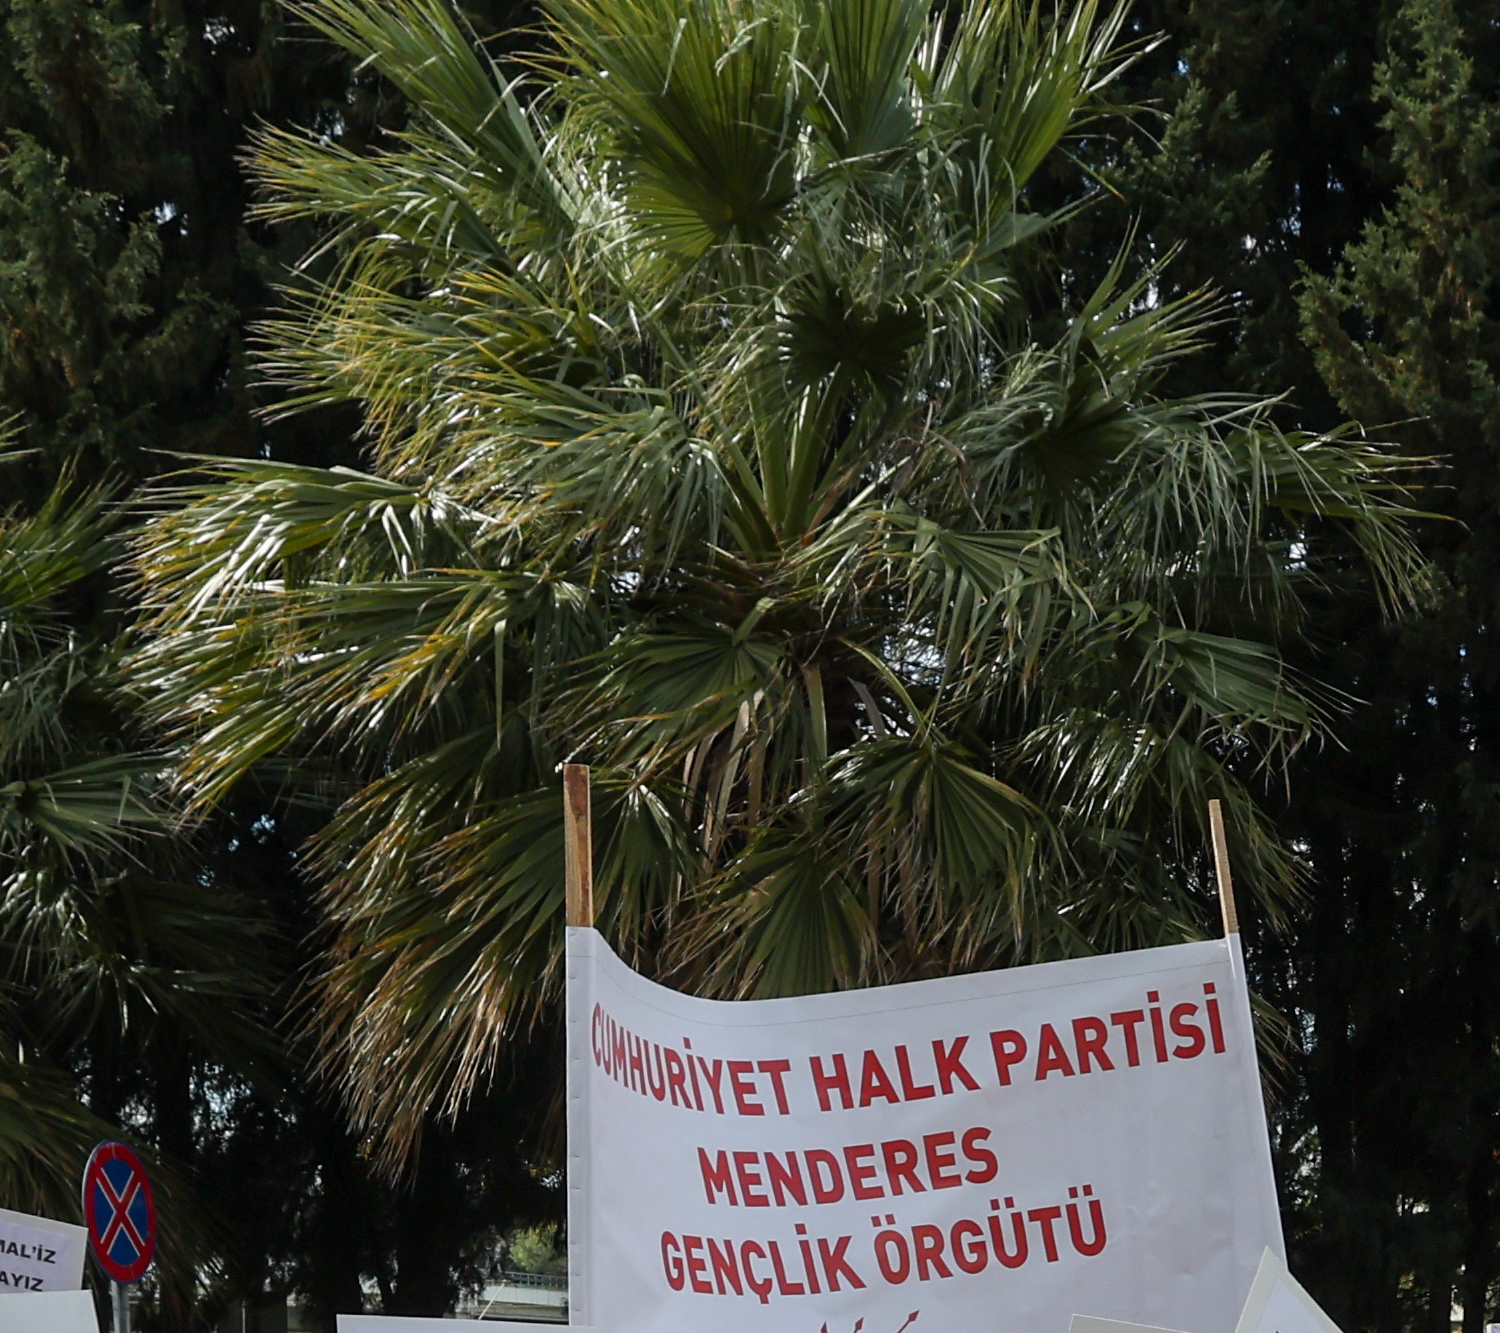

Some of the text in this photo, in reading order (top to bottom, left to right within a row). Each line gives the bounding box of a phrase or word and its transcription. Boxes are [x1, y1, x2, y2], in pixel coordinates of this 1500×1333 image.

[591, 981, 1228, 1117] CUMHURİYET HALK PARTİSİ
[698, 1125, 999, 1208] MENDERES
[661, 1184, 1108, 1304] GENÇLİK ÖRGÜTÜ
